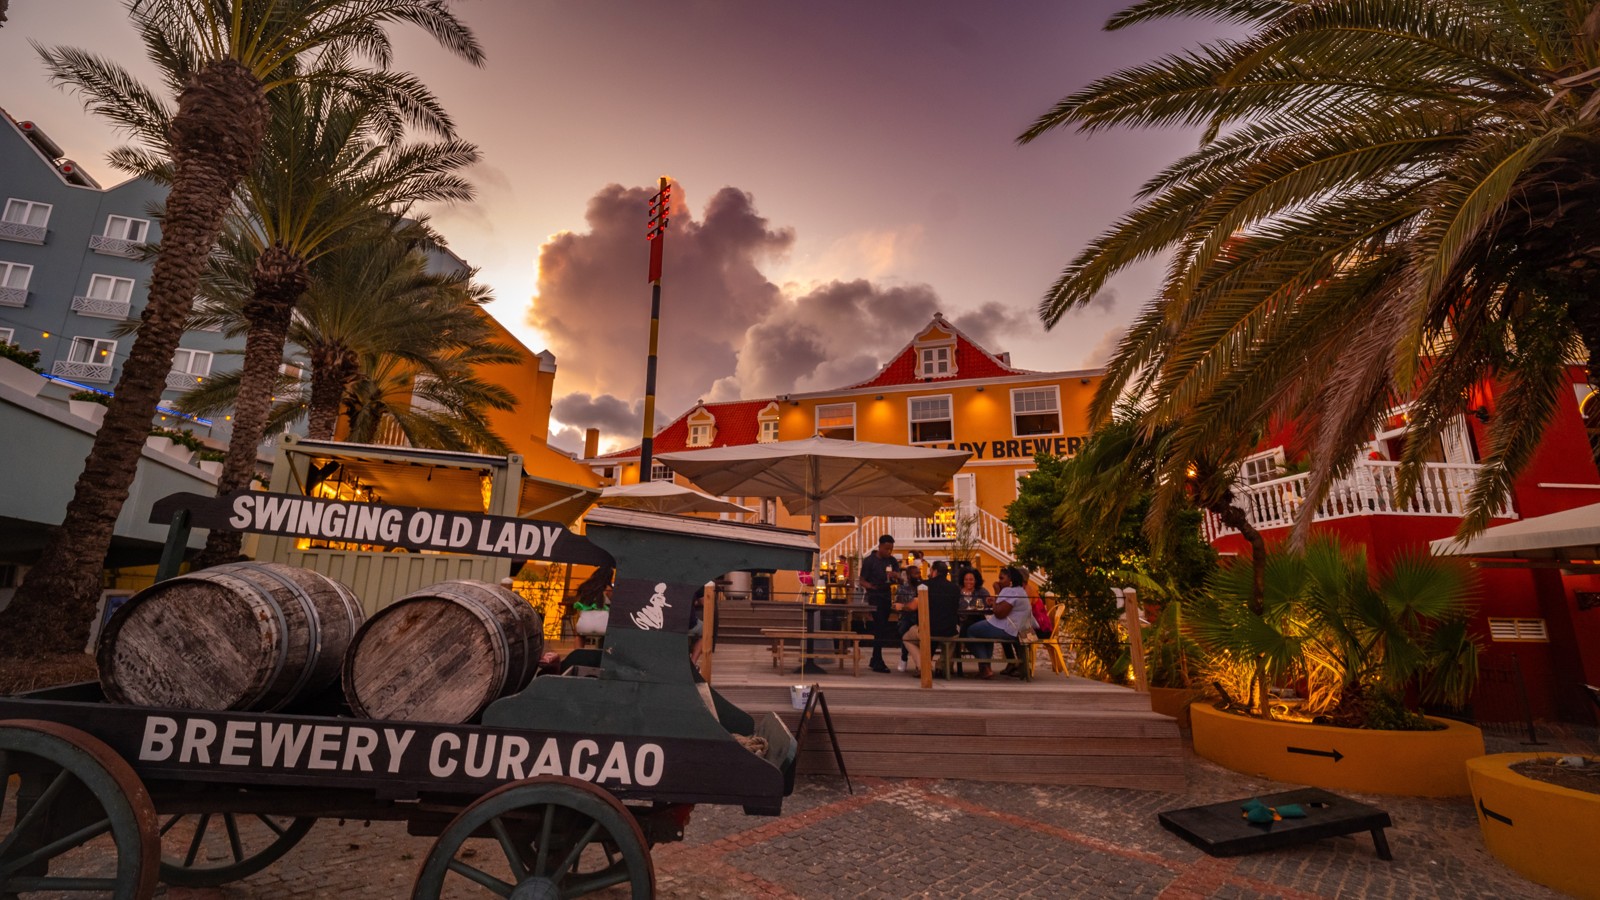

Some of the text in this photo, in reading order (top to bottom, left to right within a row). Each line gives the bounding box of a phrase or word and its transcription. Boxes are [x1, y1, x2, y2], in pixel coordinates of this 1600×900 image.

[229, 494, 563, 558] SWINGING OLD LADY
[138, 716, 665, 787] BREWERY CURACAO
